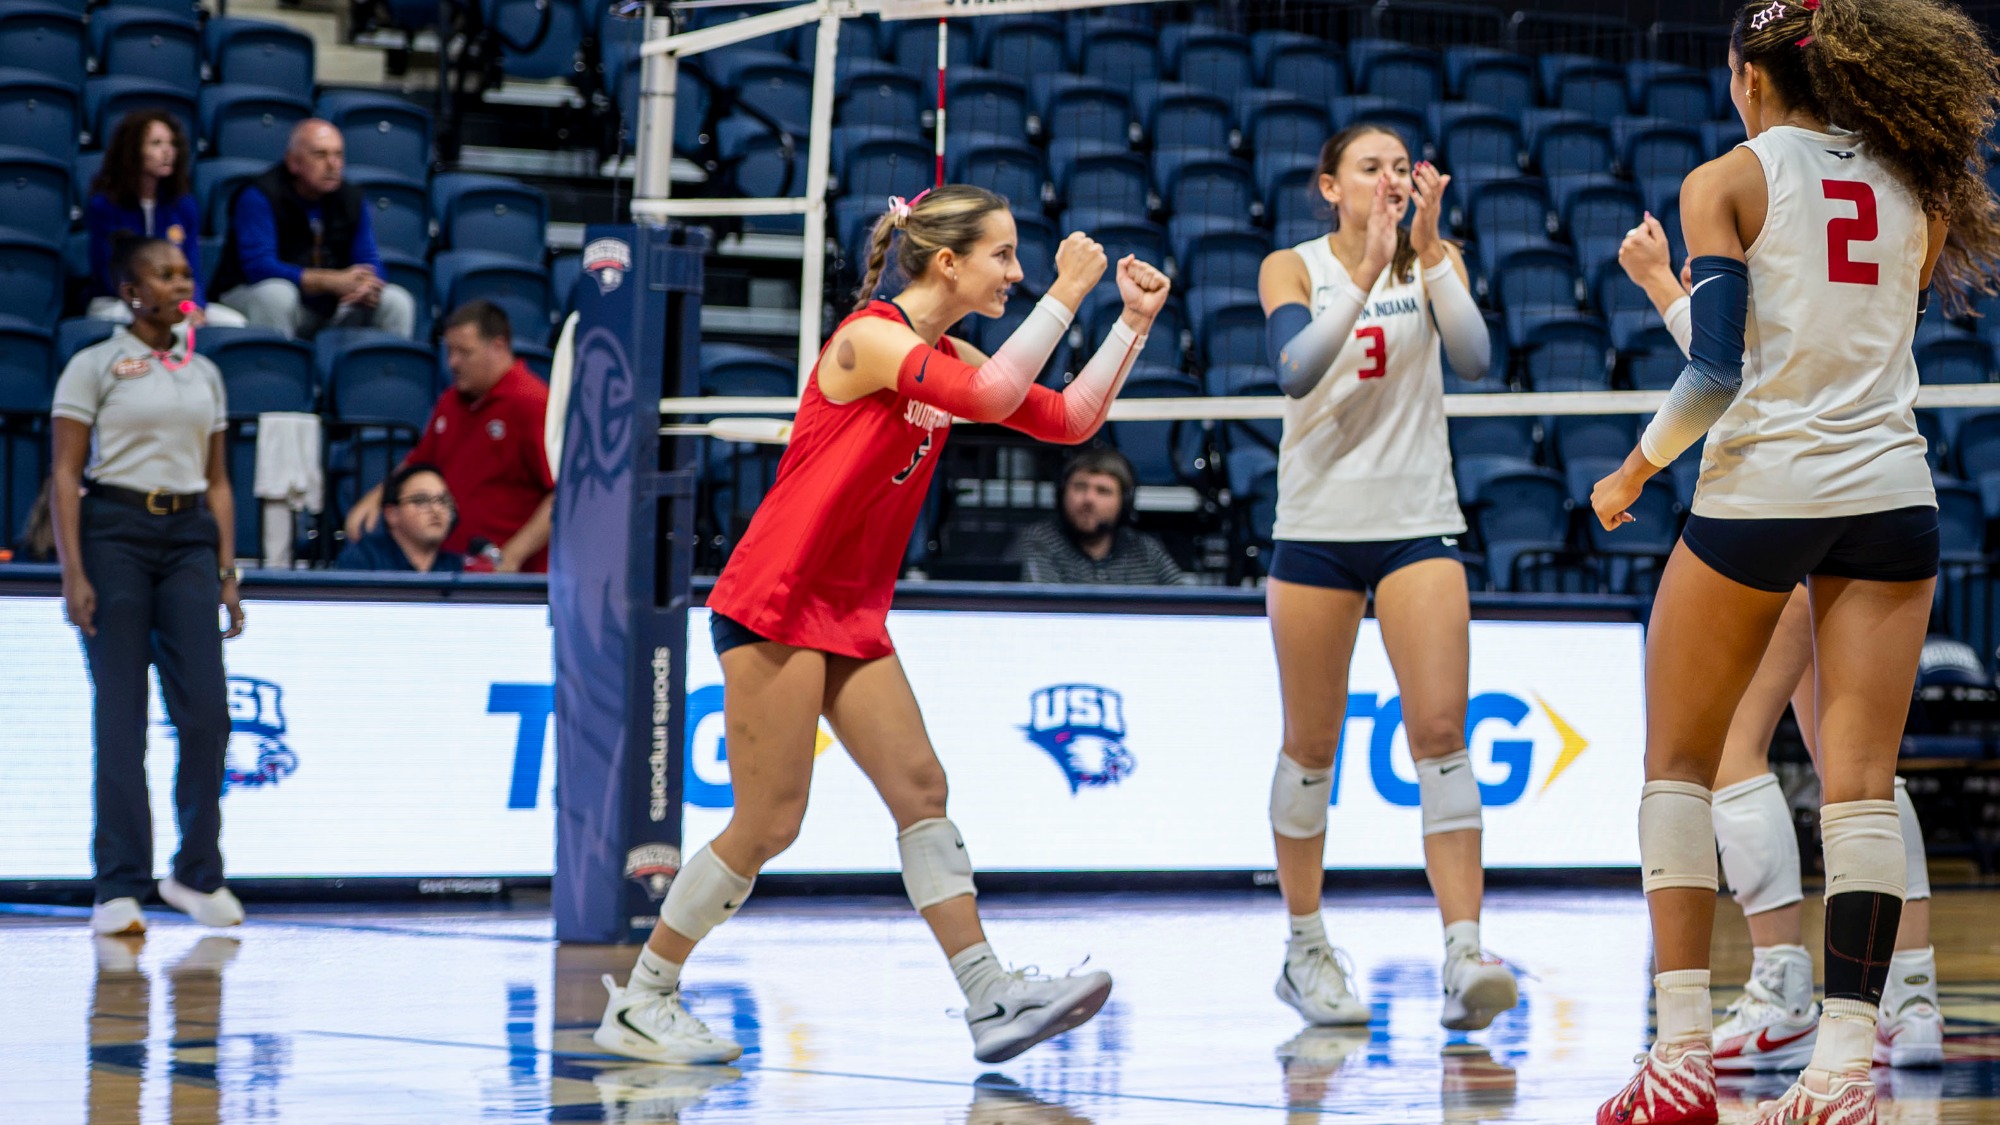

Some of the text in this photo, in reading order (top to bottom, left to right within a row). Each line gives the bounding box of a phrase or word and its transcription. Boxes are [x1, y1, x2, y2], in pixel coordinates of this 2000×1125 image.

[1821, 179, 1879, 285] 2
[1374, 297, 1418, 317] INDIANA
[1356, 326, 1386, 379] 3
[226, 678, 283, 730] SI
[1033, 686, 1123, 732] USI
[648, 646, 671, 822] sports imports
